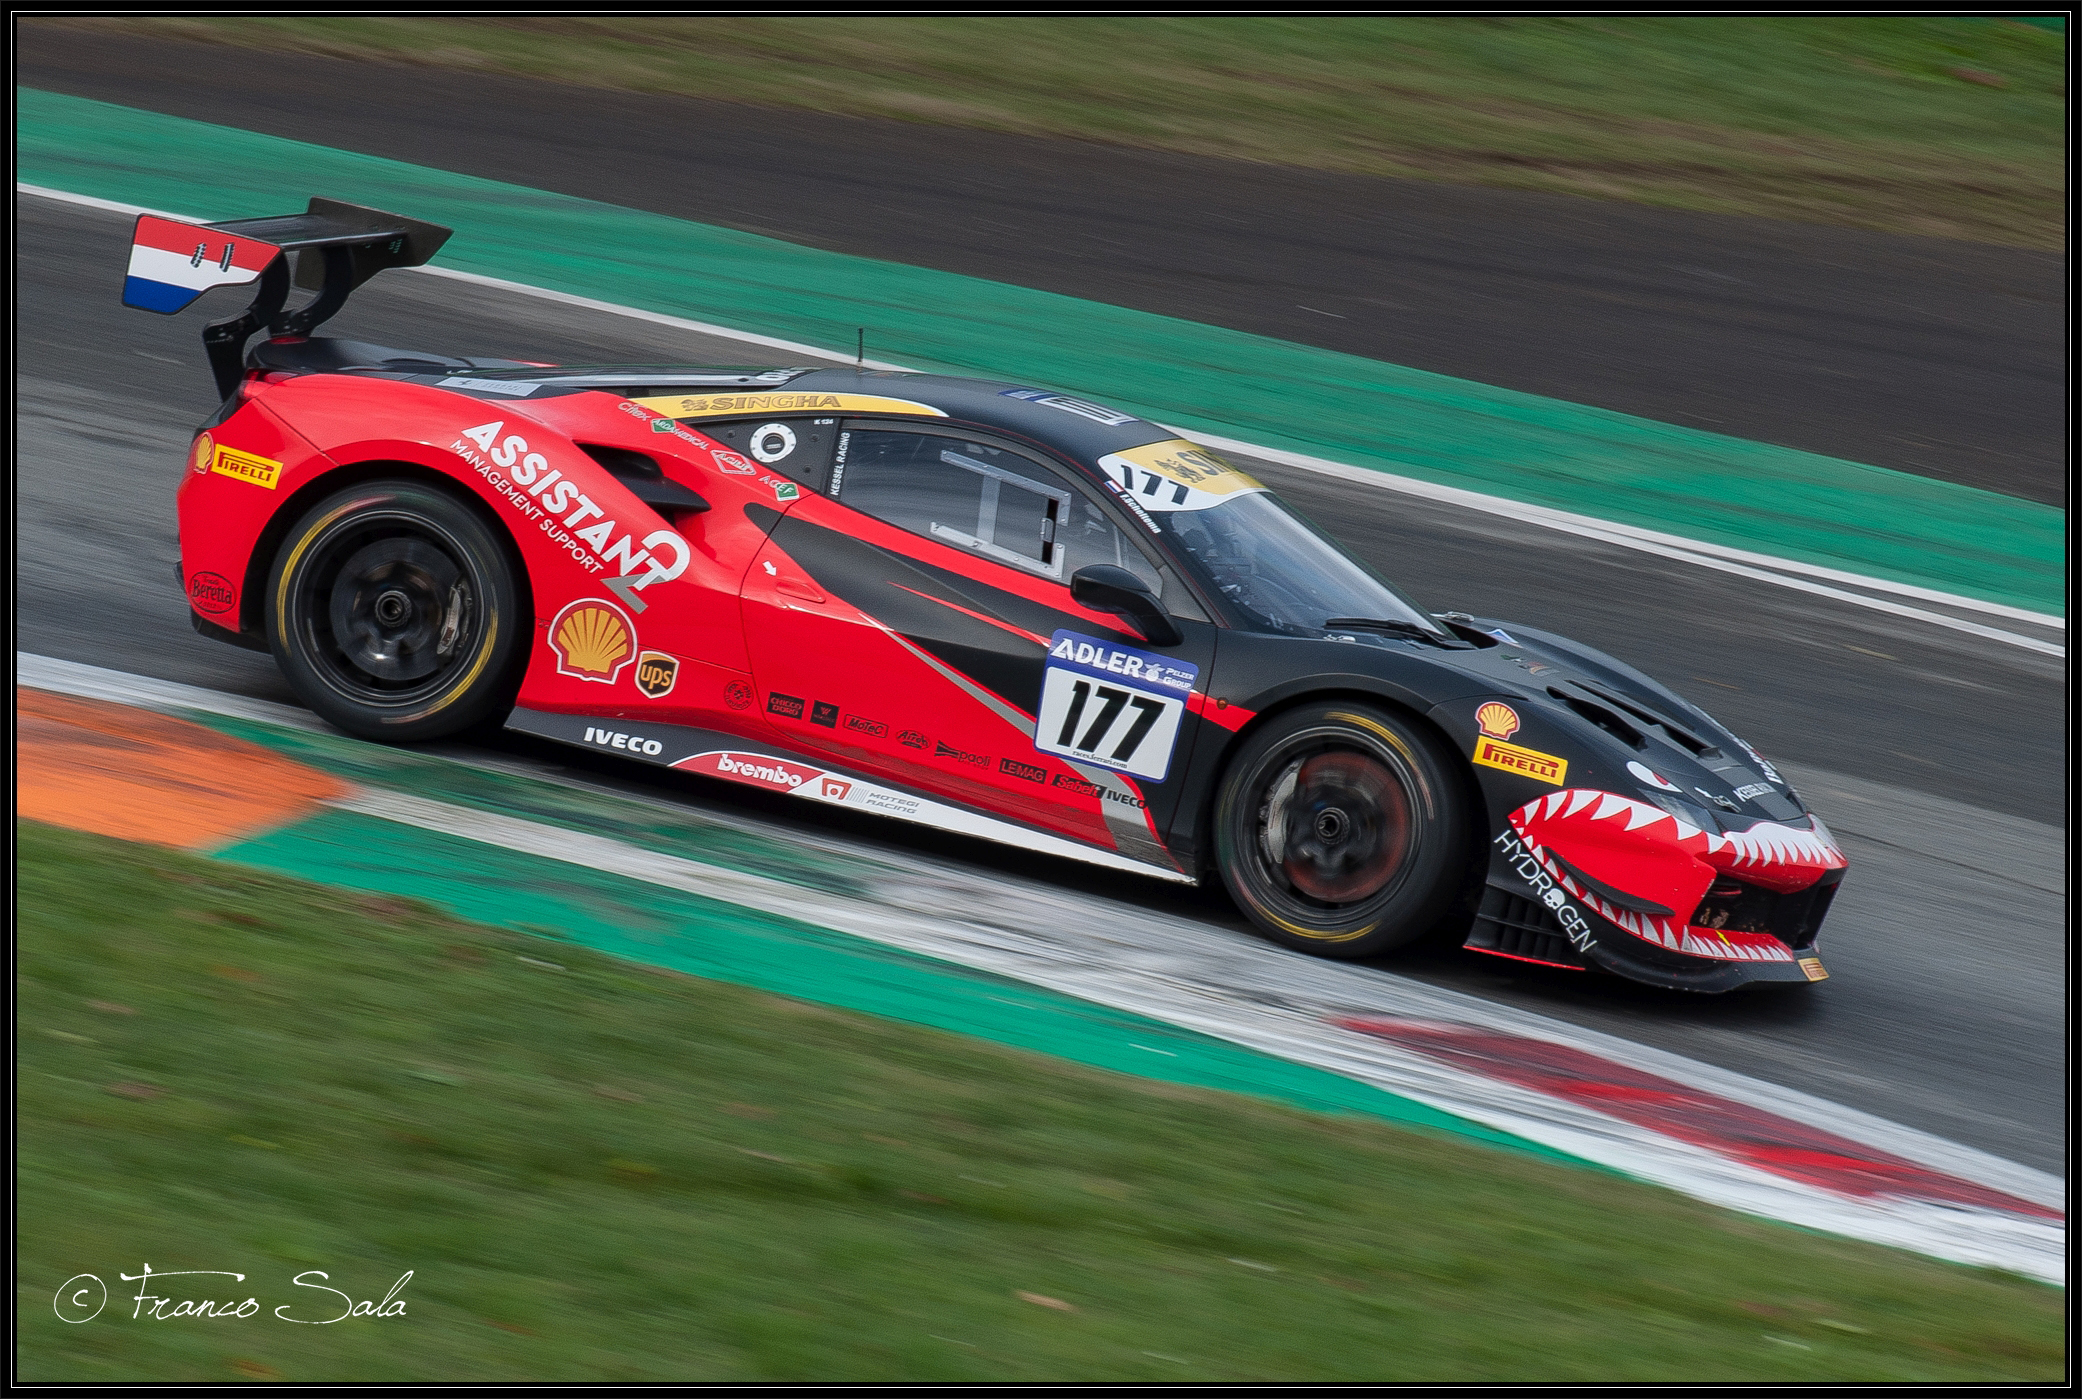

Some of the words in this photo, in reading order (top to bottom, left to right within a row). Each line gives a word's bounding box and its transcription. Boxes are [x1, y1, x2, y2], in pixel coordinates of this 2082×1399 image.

[709, 395, 842, 410] SINGHA
[835, 431, 851, 463] RACING
[217, 451, 276, 482] PIRELLI
[829, 463, 845, 496] KESSEL
[1119, 464, 1190, 506] 177
[450, 439, 545, 521] MANAGEMENT
[538, 517, 605, 574] SUPPORT
[1050, 637, 1144, 679] ADLER
[1056, 679, 1167, 763] 177
[583, 727, 663, 756] IVECO
[717, 754, 803, 787] brembo
[1482, 743, 1560, 778] PIRELLI
[866, 799, 918, 814] RACING
[869, 792, 921, 808] MOTEGI
[1107, 790, 1147, 809] IVECO
